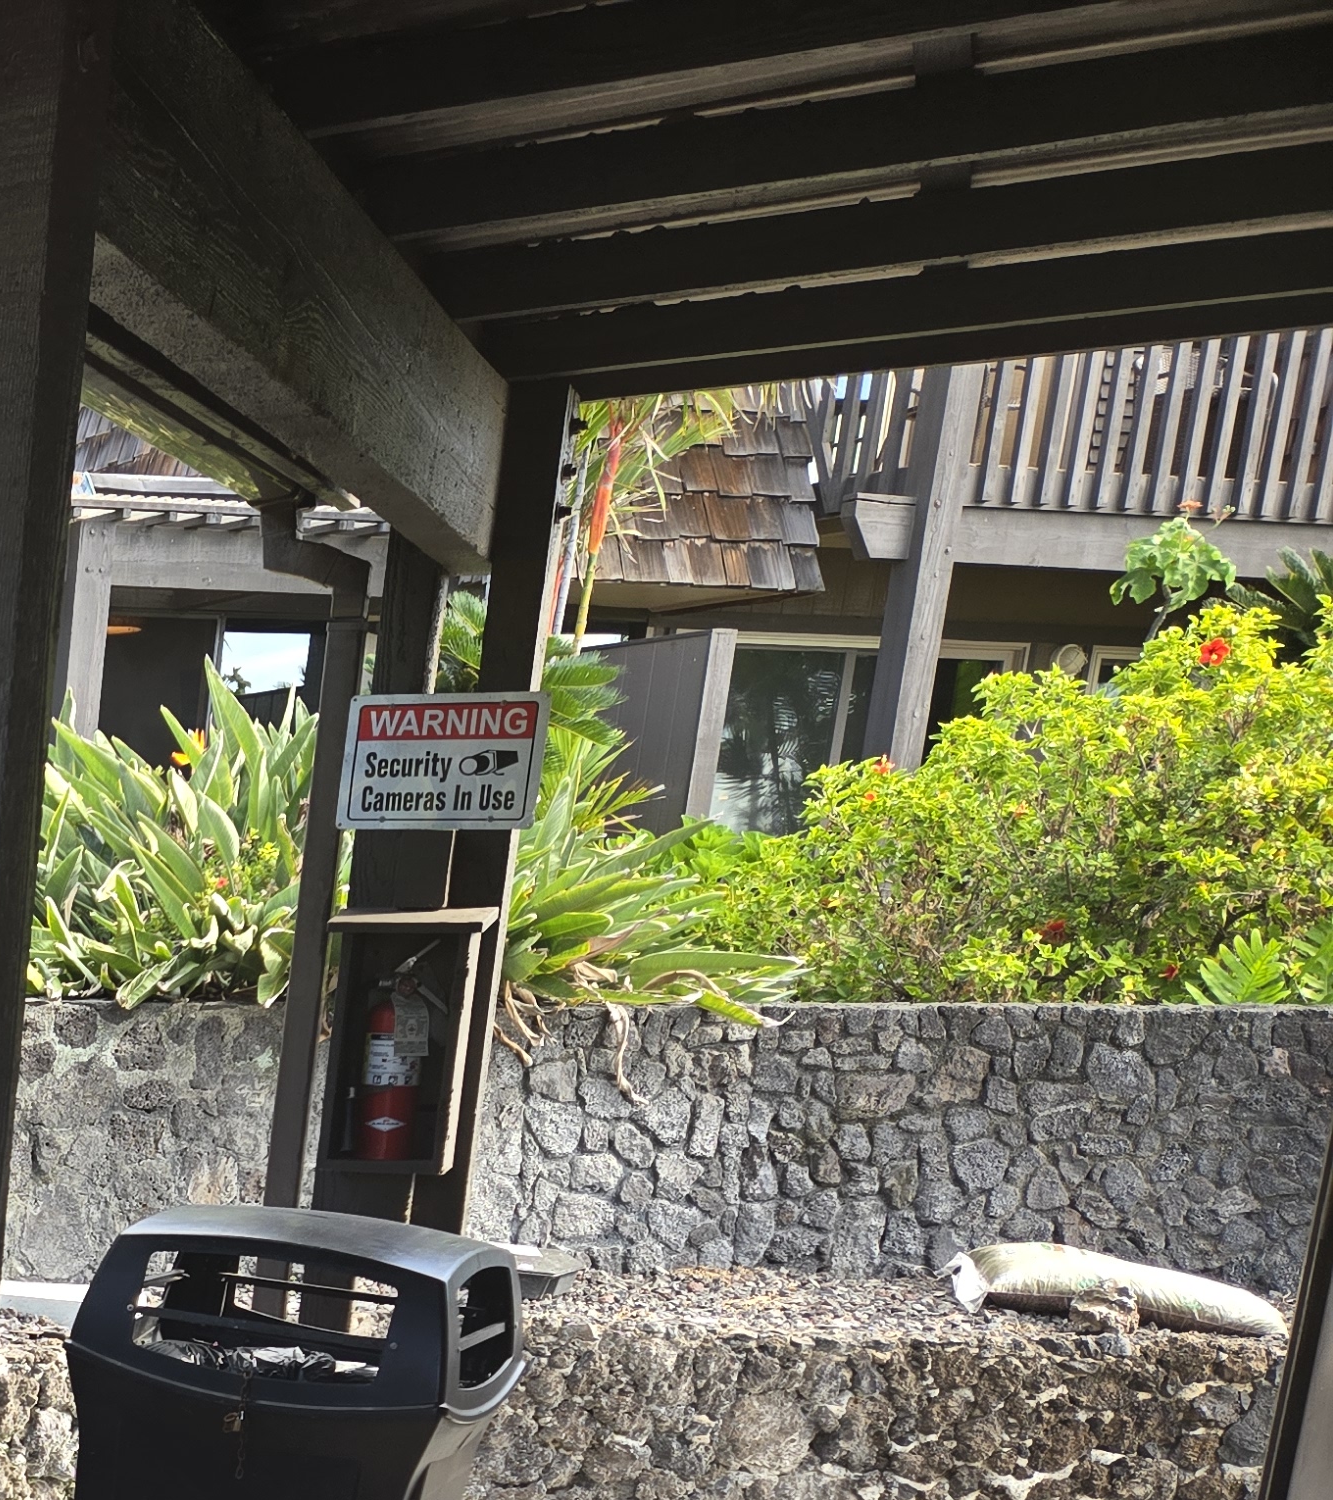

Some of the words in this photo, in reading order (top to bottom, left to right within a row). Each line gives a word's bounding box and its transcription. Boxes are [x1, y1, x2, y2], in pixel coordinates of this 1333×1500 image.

[370, 707, 528, 737] WARNING
[364, 751, 453, 783] Security
[361, 786, 447, 813] Cameras
[452, 784, 472, 811] In
[478, 784, 516, 811] Use
